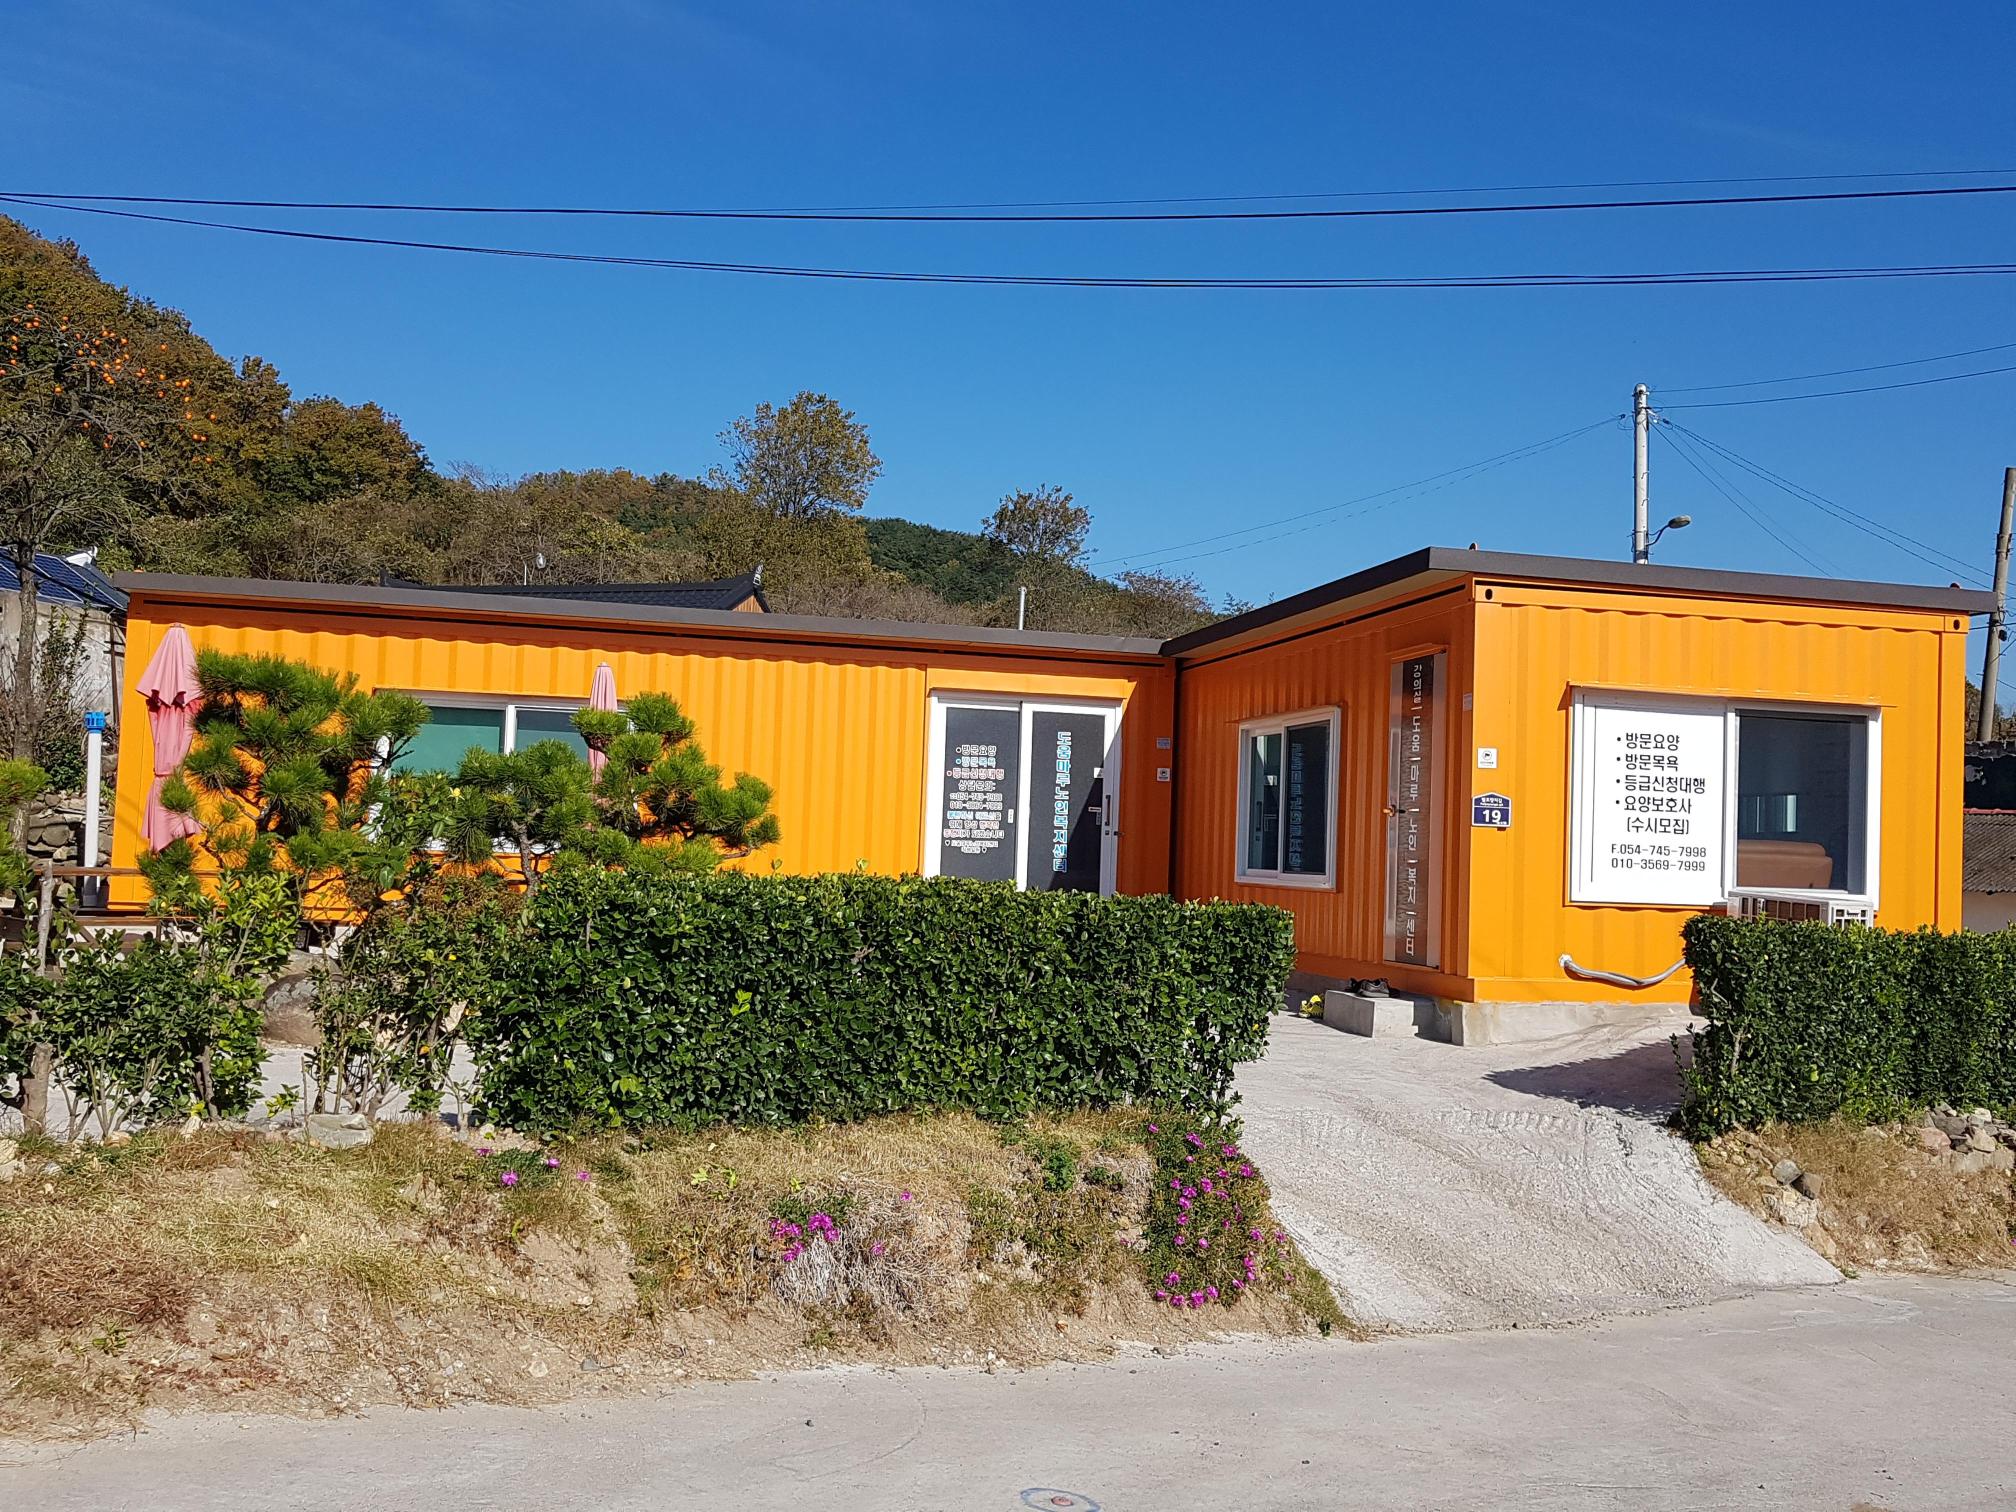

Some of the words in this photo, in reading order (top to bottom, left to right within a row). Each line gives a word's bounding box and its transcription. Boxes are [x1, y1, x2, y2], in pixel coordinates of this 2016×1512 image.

[1411, 715, 1421, 752] 도움
[1625, 732, 1680, 751] 방문요양
[1625, 753, 1679, 772] 방문목욕
[1409, 765, 1420, 801] 마루
[1624, 774, 1706, 794] 등급신청대행
[1624, 795, 1692, 814] 요양보호사
[1482, 809, 1502, 823] 19
[1408, 819, 1418, 851] 노인
[1611, 843, 1707, 858] F.054-745-7998
[1611, 857, 1706, 872] 010-3569-7999
[1407, 868, 1416, 905] 복지
[1405, 918, 1415, 957] 센터
